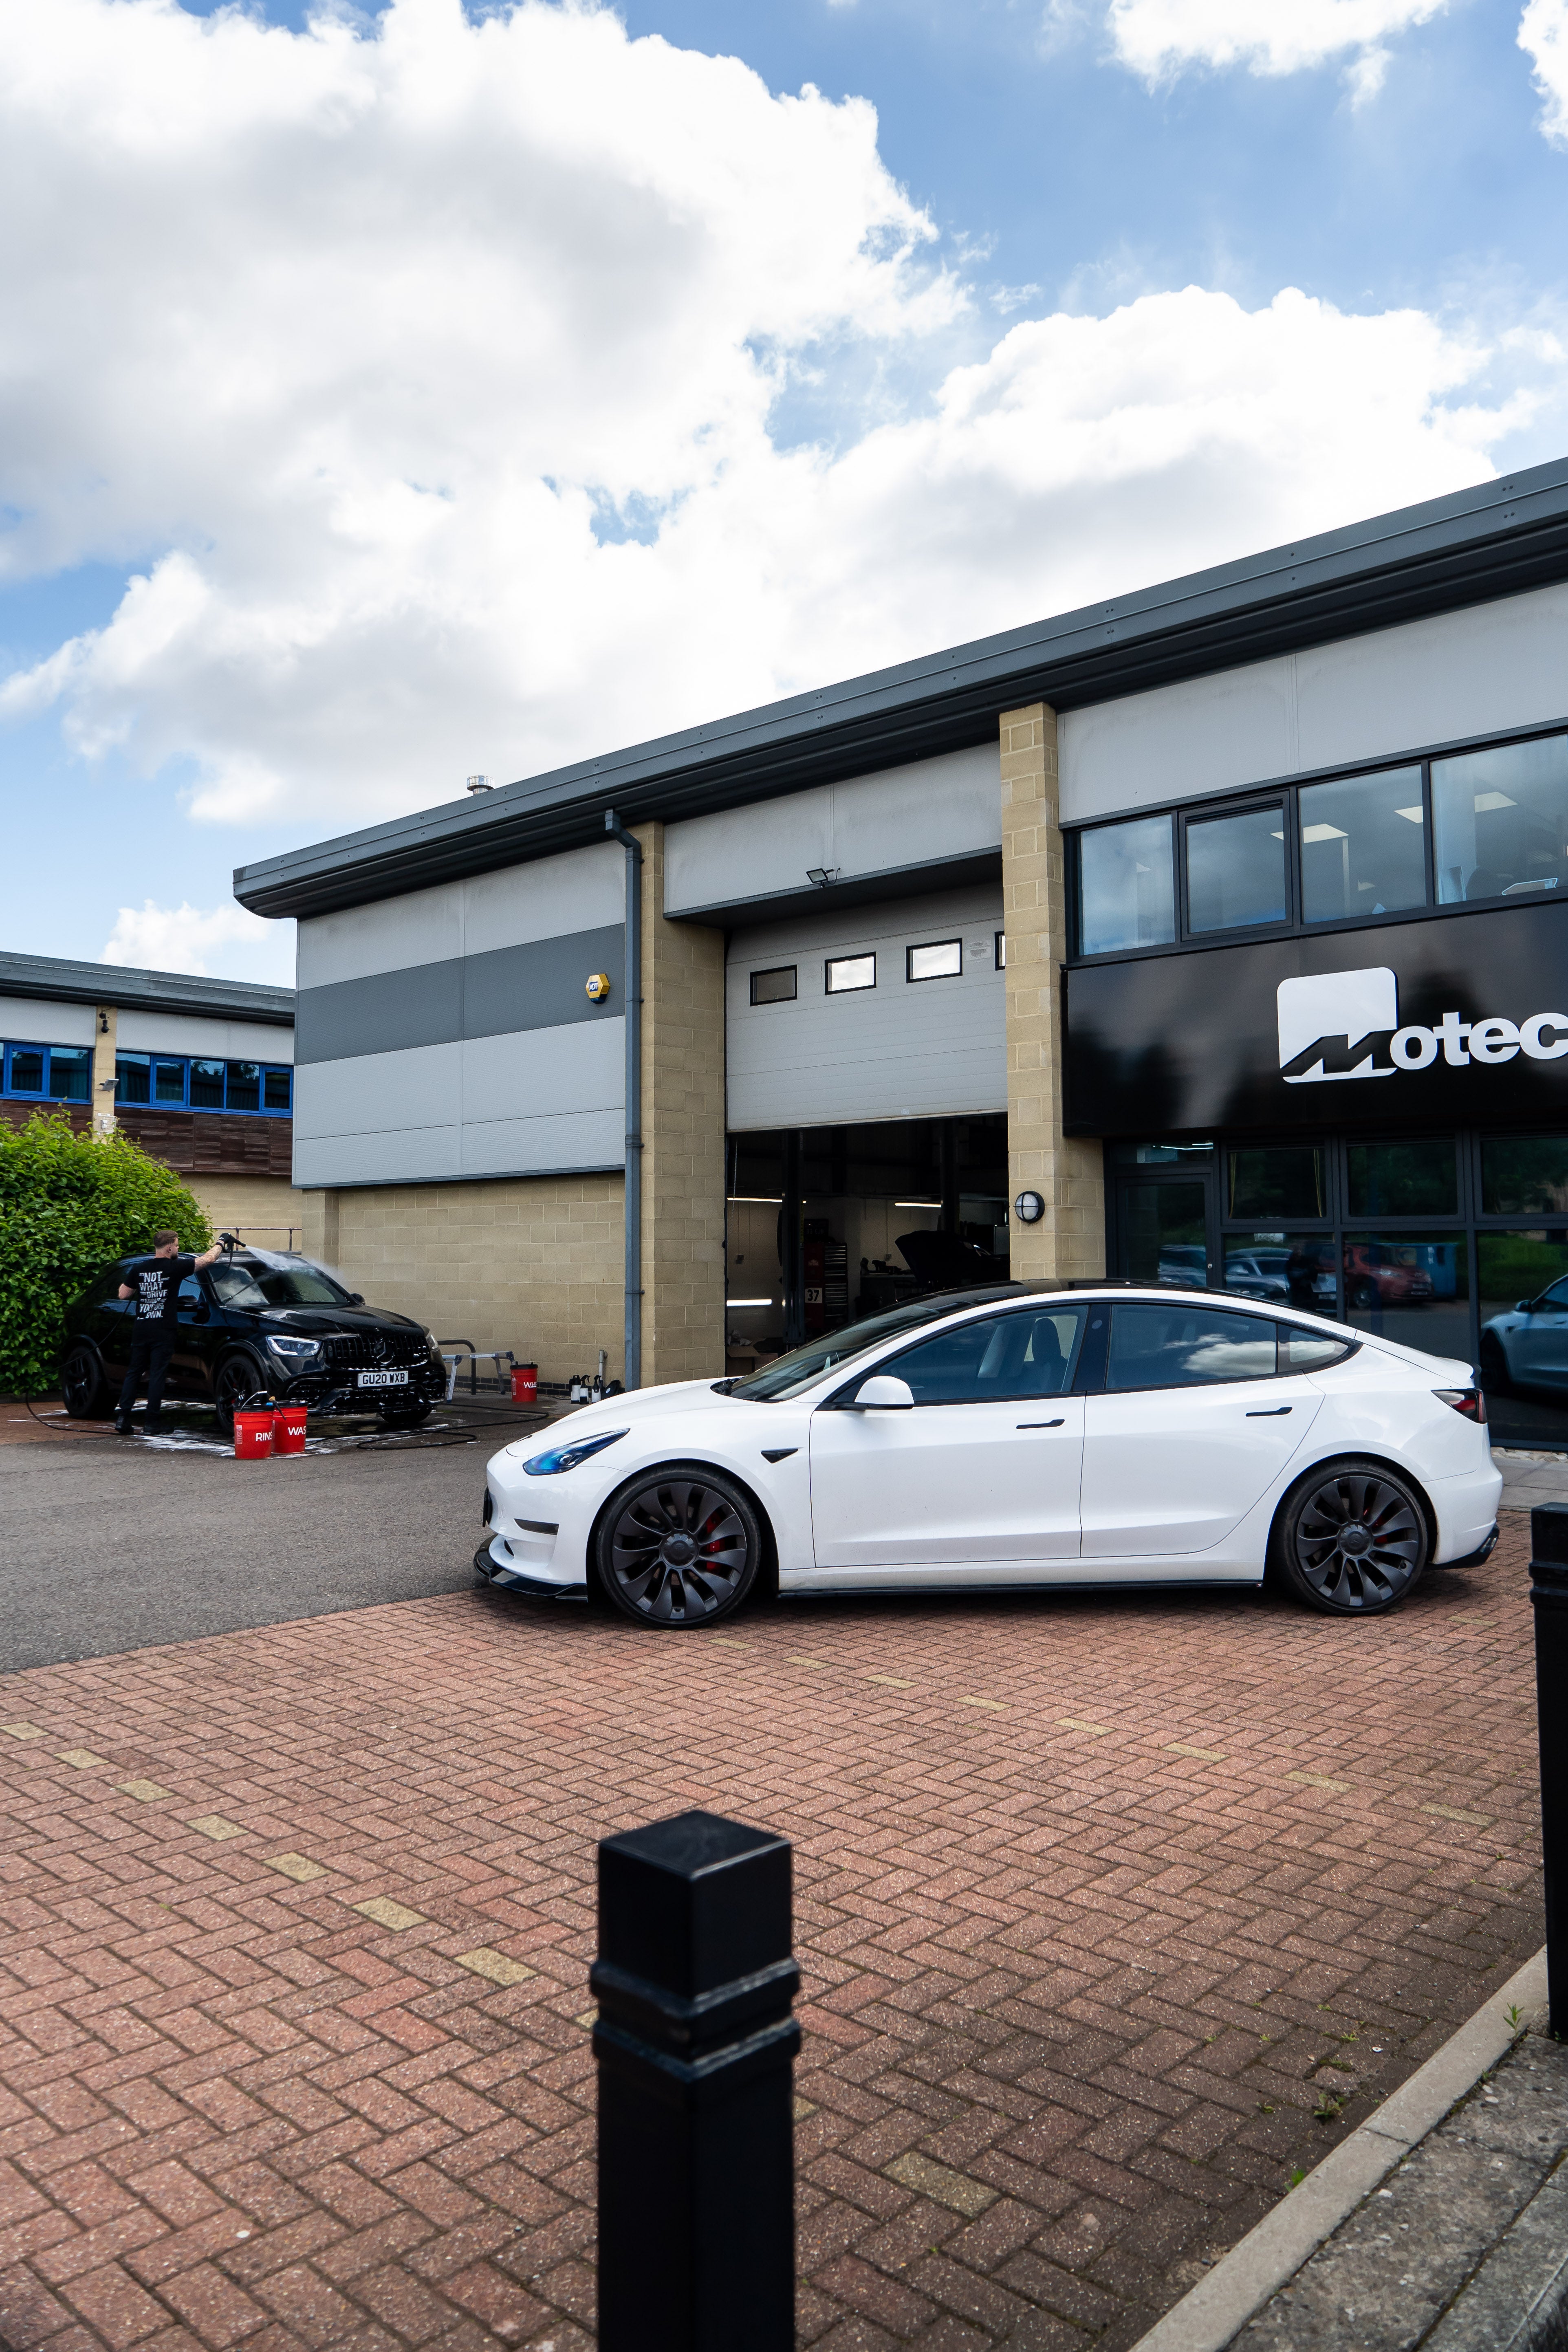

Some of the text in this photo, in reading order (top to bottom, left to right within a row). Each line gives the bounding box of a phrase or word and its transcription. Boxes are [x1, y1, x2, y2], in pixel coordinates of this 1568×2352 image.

[589, 982, 598, 991] ADT
[144, 1271, 163, 1282] NOT
[139, 1282, 163, 1291] WHAT
[807, 1289, 819, 1302] 37
[363, 1372, 405, 1385] GU20 WXB
[255, 1431, 273, 1441] RINS
